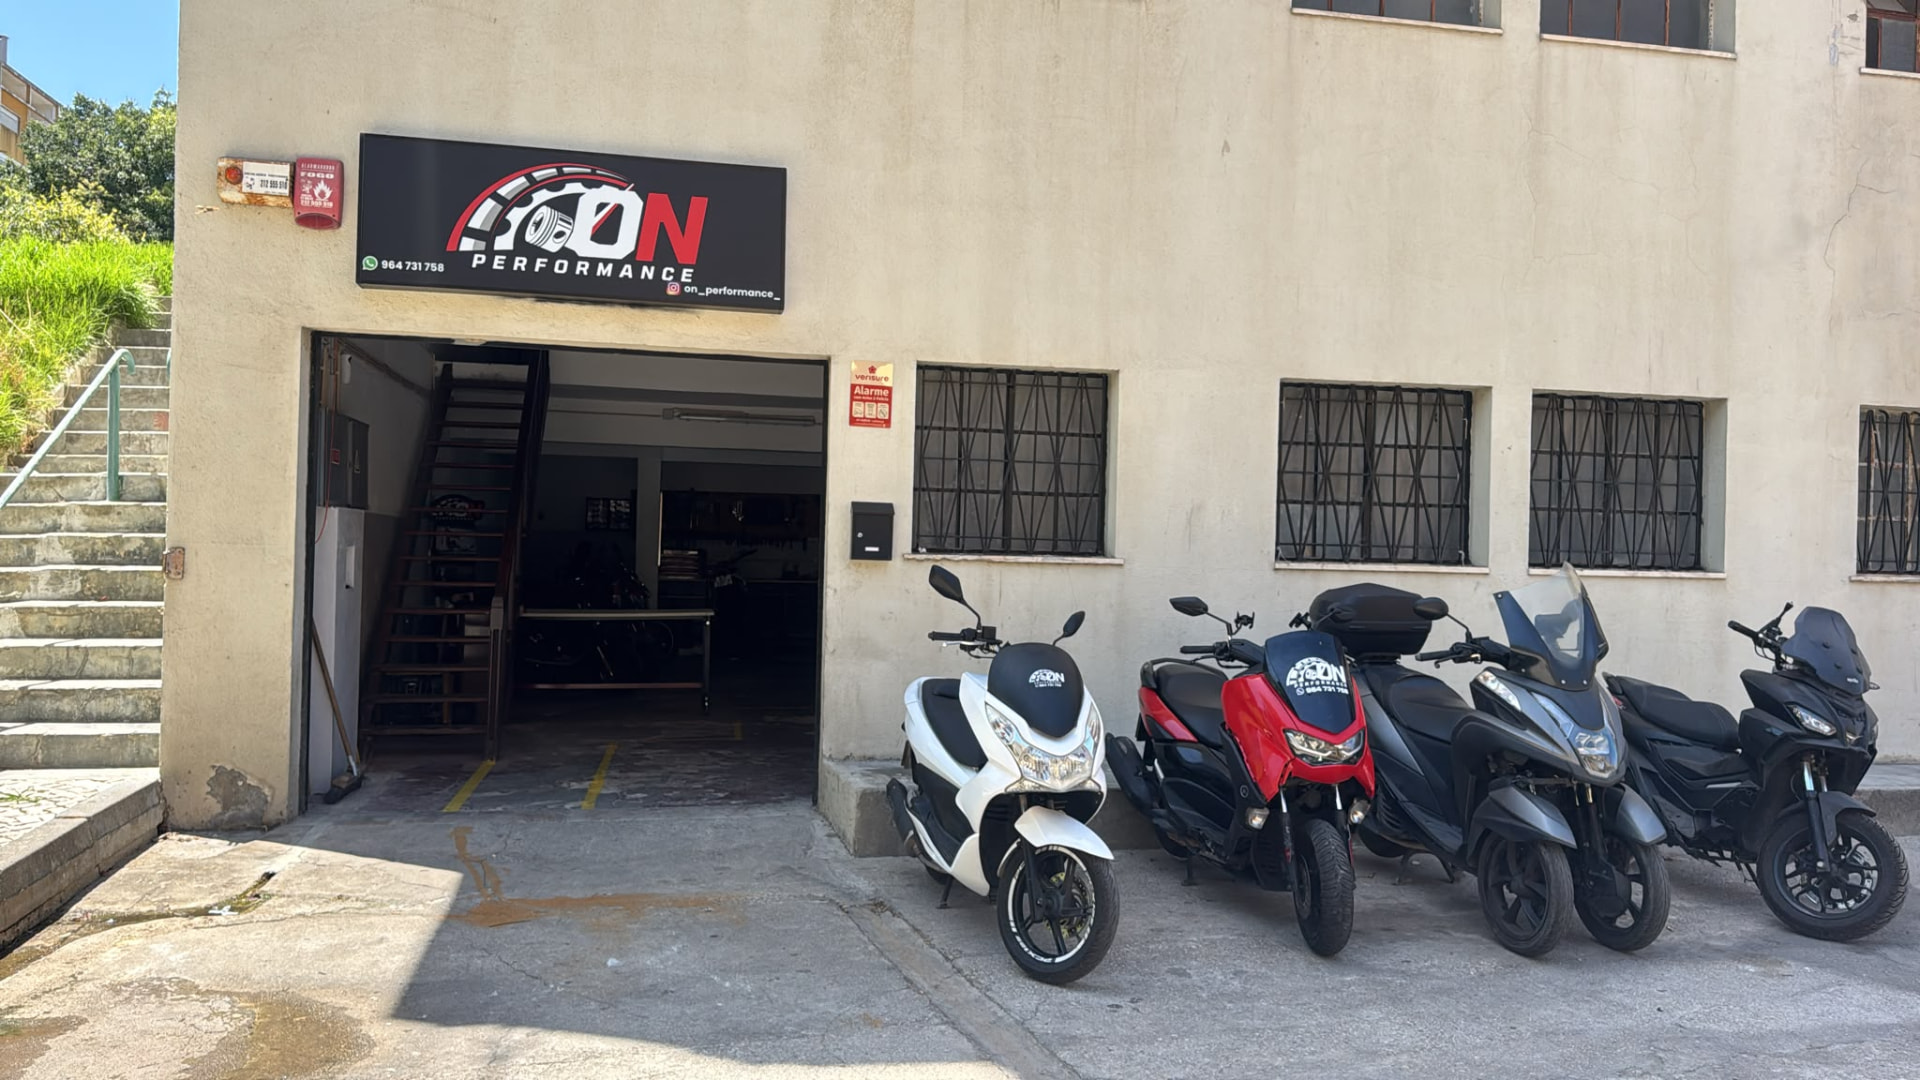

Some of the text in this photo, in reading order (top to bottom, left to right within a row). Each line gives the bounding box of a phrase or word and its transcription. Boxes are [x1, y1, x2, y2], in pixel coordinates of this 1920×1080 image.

[381, 259, 445, 272] 964 731 758
[471, 253, 695, 283] PERFORMANCE
[684, 285, 781, 301] on_performance_
[854, 386, 889, 396] Alarme
